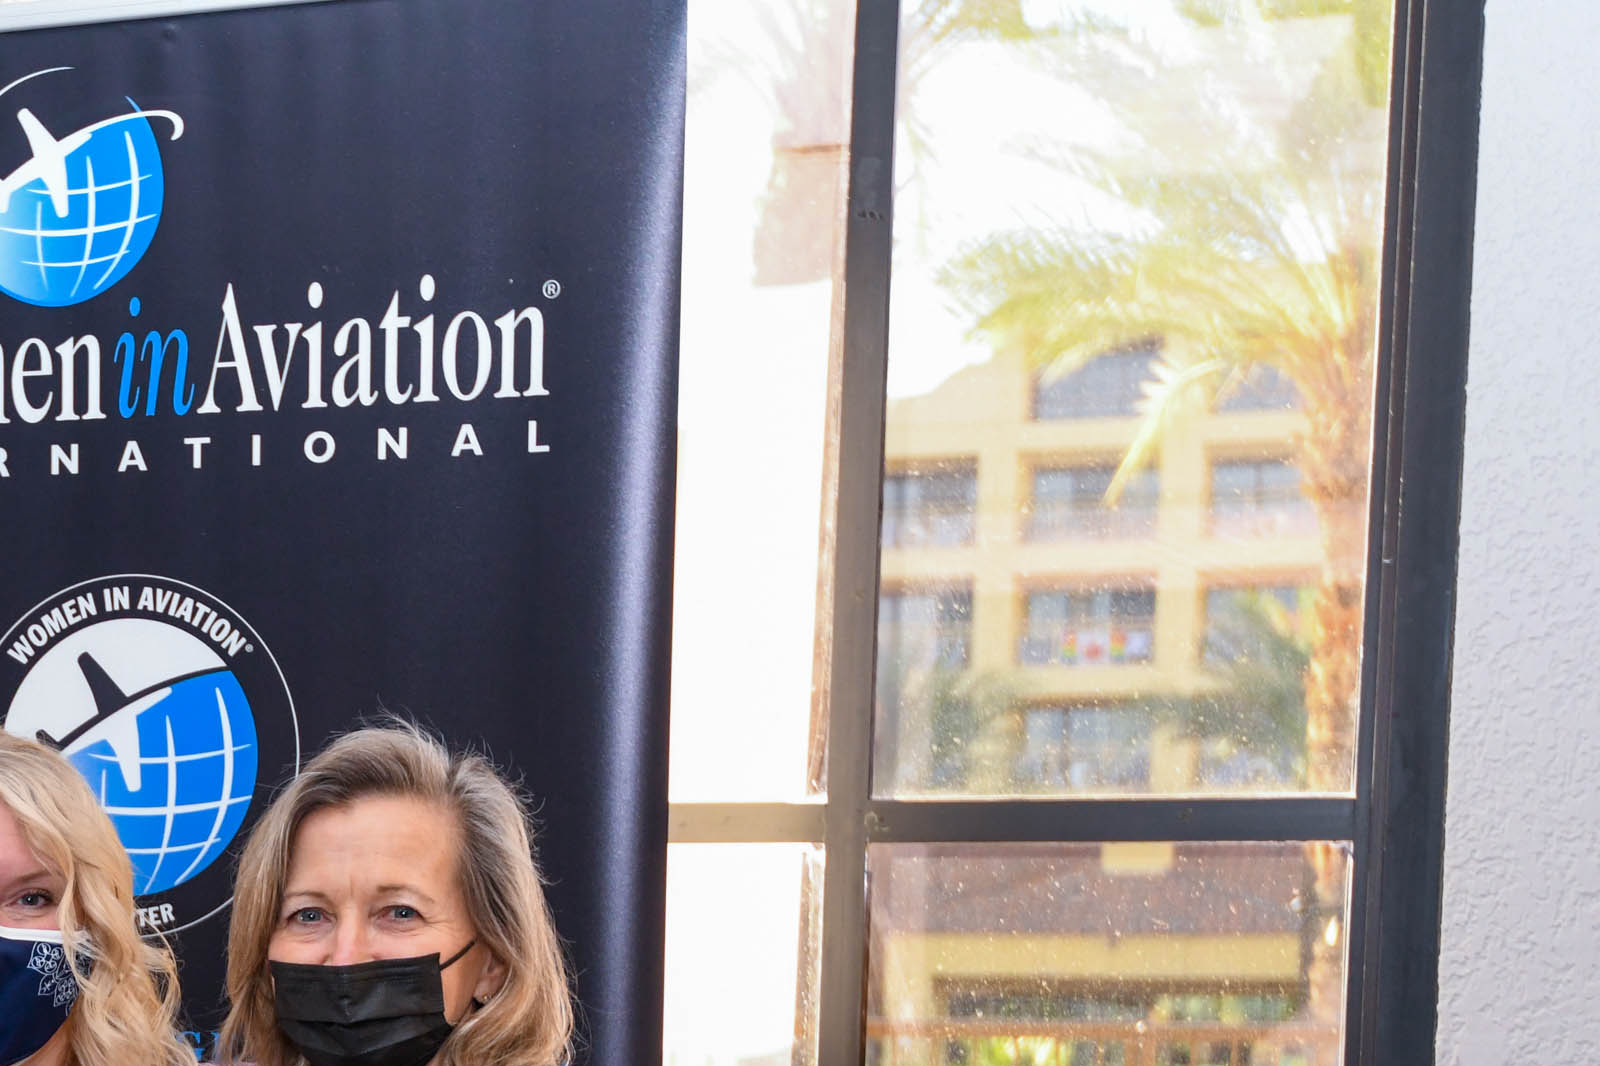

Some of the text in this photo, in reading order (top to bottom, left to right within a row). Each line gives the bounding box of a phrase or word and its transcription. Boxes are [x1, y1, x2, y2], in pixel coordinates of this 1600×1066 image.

[112, 296, 196, 420] in
[7, 592, 97, 664] WOMEN
[103, 586, 130, 612] IN
[136, 903, 175, 927] TER
